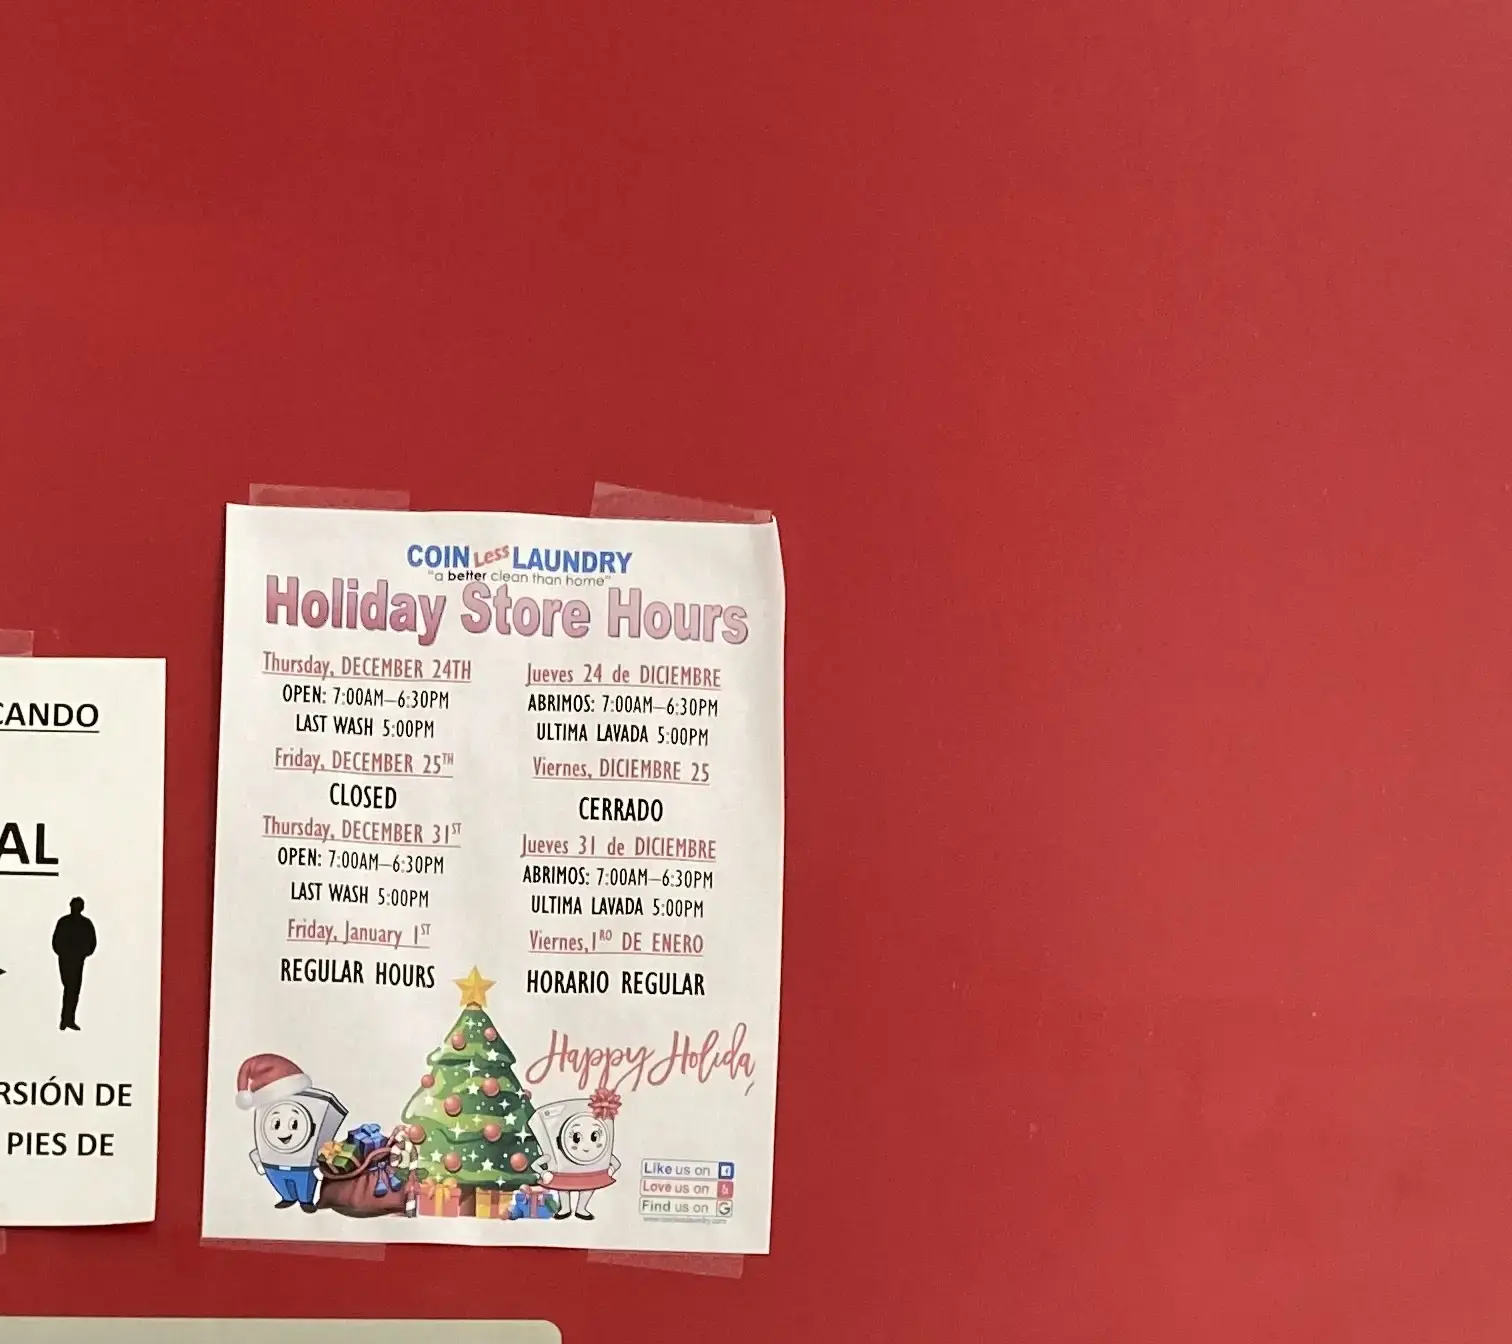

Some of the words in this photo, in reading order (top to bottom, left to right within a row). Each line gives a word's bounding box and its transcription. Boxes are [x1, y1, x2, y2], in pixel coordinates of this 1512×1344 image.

[408, 545, 469, 568] COIN
[474, 545, 509, 568] Less
[513, 547, 632, 573] LAUNDRY
[265, 575, 446, 646] Holiday
[461, 581, 591, 638] Store
[608, 587, 748, 644] Hours
[263, 651, 335, 679] Thursday,
[342, 655, 424, 678] DECEMBER
[432, 659, 471, 680] 24TH
[525, 663, 574, 686] Jueves
[583, 664, 603, 683] 24
[612, 664, 630, 683] de
[639, 665, 721, 687] DICIEMBRE
[283, 684, 326, 703] OPEN:
[528, 694, 594, 712] ABRIMOS:
[296, 714, 328, 732] LAST
[333, 716, 373, 736] WASH
[383, 719, 434, 738] 5:00PM
[537, 723, 587, 741] ULTIMA
[597, 724, 648, 742] LAVADA
[658, 726, 708, 746] 5:00PM
[275, 747, 325, 771] Friday,
[332, 751, 413, 773] DECEMBER
[532, 756, 592, 780] Viernes,
[598, 759, 682, 781] DICIEMBRE
[690, 763, 710, 782] 25
[329, 782, 397, 809] CLOSED
[579, 797, 663, 822] CERRADO
[263, 815, 335, 842] Thursday,
[342, 820, 424, 842] DECEMBER
[287, 918, 337, 943] Friday,
[343, 920, 402, 946] January
[281, 958, 364, 983] REGULAR
[376, 962, 434, 988] HOURS
[527, 970, 609, 993] HORARIO
[622, 971, 705, 995] REGULAR
[525, 1029, 655, 1091] Happy
[647, 1022, 756, 1096] Holida
[96, 1083, 132, 1106] DE
[8, 1132, 67, 1156] PIES
[78, 1133, 114, 1156] DE
